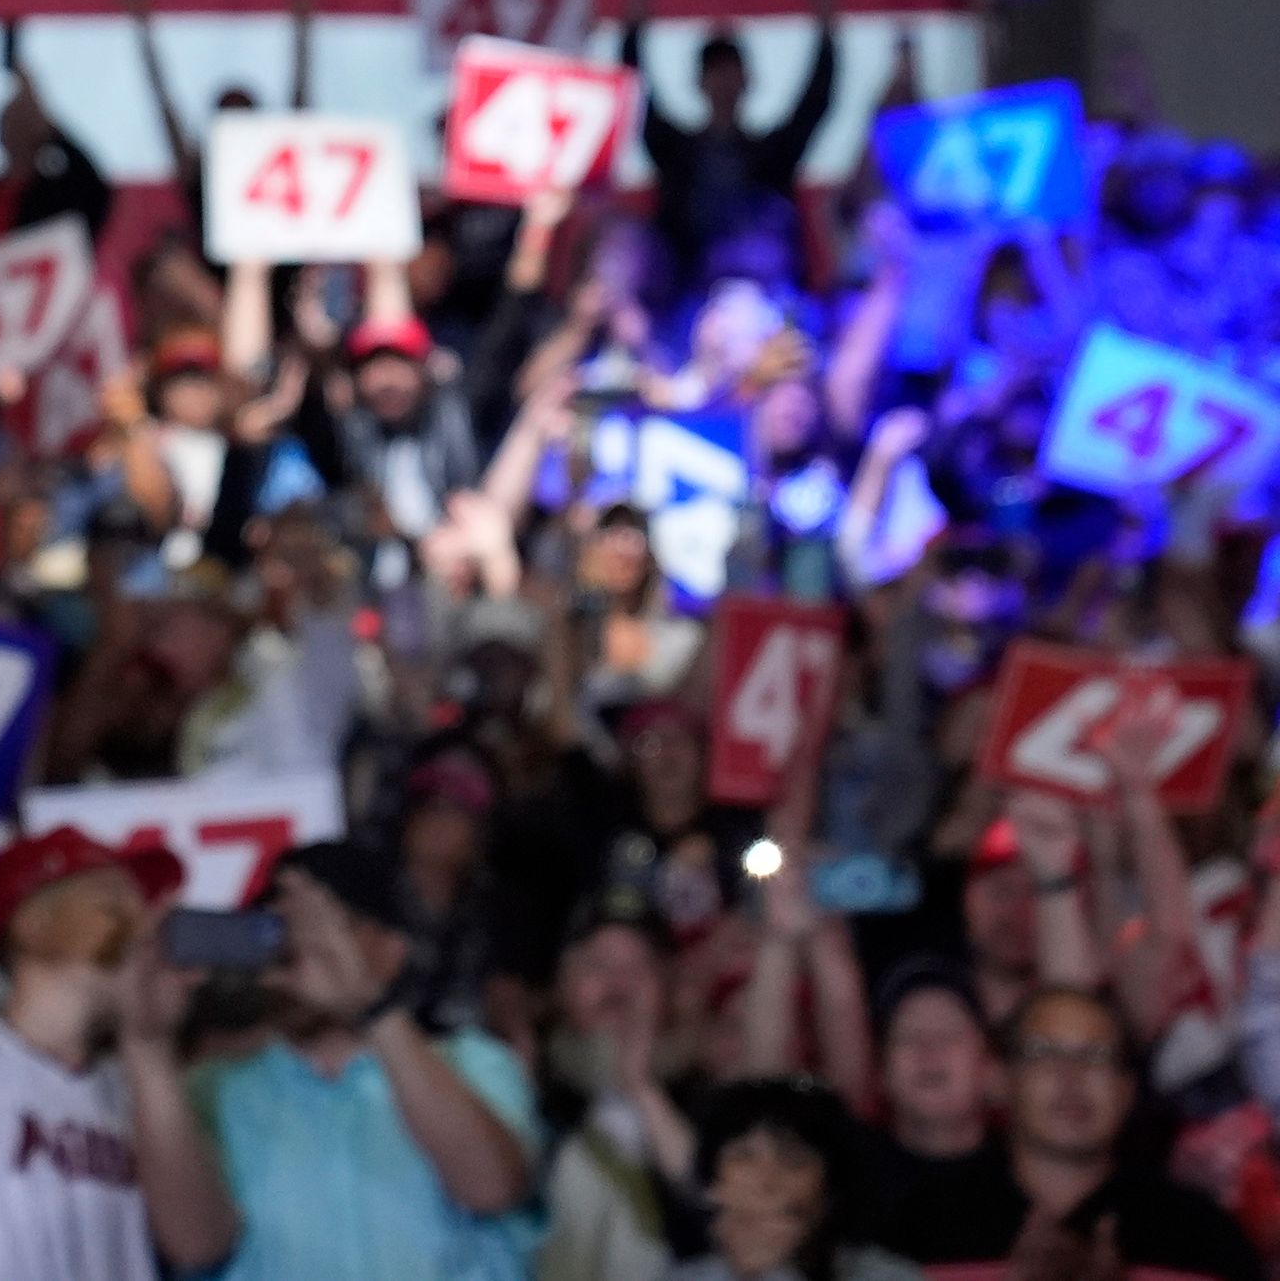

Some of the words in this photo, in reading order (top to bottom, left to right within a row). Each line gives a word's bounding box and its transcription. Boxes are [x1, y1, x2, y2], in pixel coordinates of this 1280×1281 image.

[466, 73, 617, 187] 47
[911, 115, 1057, 210] 47
[246, 141, 377, 218] 47
[1090, 383, 1249, 485] 47
